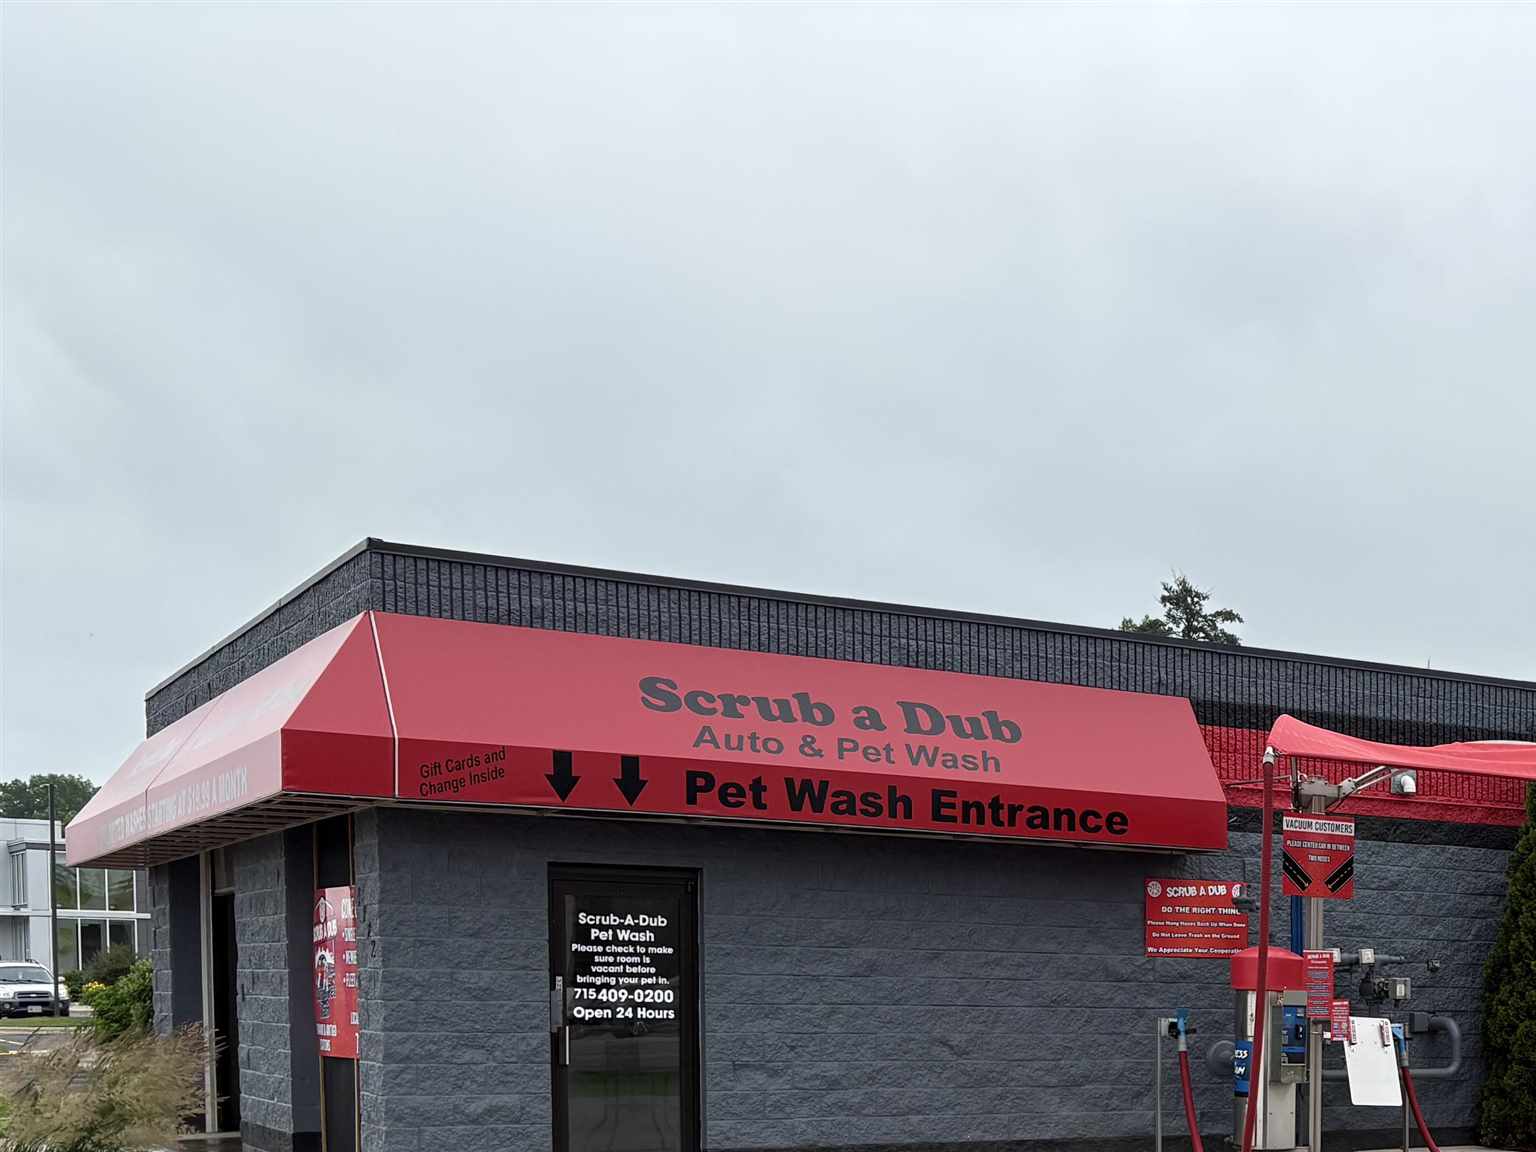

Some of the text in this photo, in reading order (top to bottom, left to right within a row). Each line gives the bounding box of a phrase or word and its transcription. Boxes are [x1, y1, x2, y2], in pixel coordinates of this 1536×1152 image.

[639, 676, 1022, 744] Scrub a Dub
[692, 725, 1001, 773] Auto & Pet Wash
[420, 745, 506, 779] Gift Cards and
[420, 766, 505, 797] Change Inside
[686, 770, 1129, 835] Pet Wash Entrance
[1285, 818, 1353, 834] VACUUM CUSTOMERS
[1166, 885, 1227, 898] SCRUB A DUB
[1175, 906, 1190, 914] THE
[578, 912, 668, 927] Scrub-A-Dub
[591, 928, 655, 942] Pet Wash
[571, 943, 674, 954] Please check to make
[594, 955, 651, 964] sure room is
[591, 965, 656, 974] vacant before
[576, 974, 616, 985] bringing
[640, 976, 656, 985] pet
[658, 976, 670, 985] in.
[573, 1006, 675, 1020] Open 24 Hours
